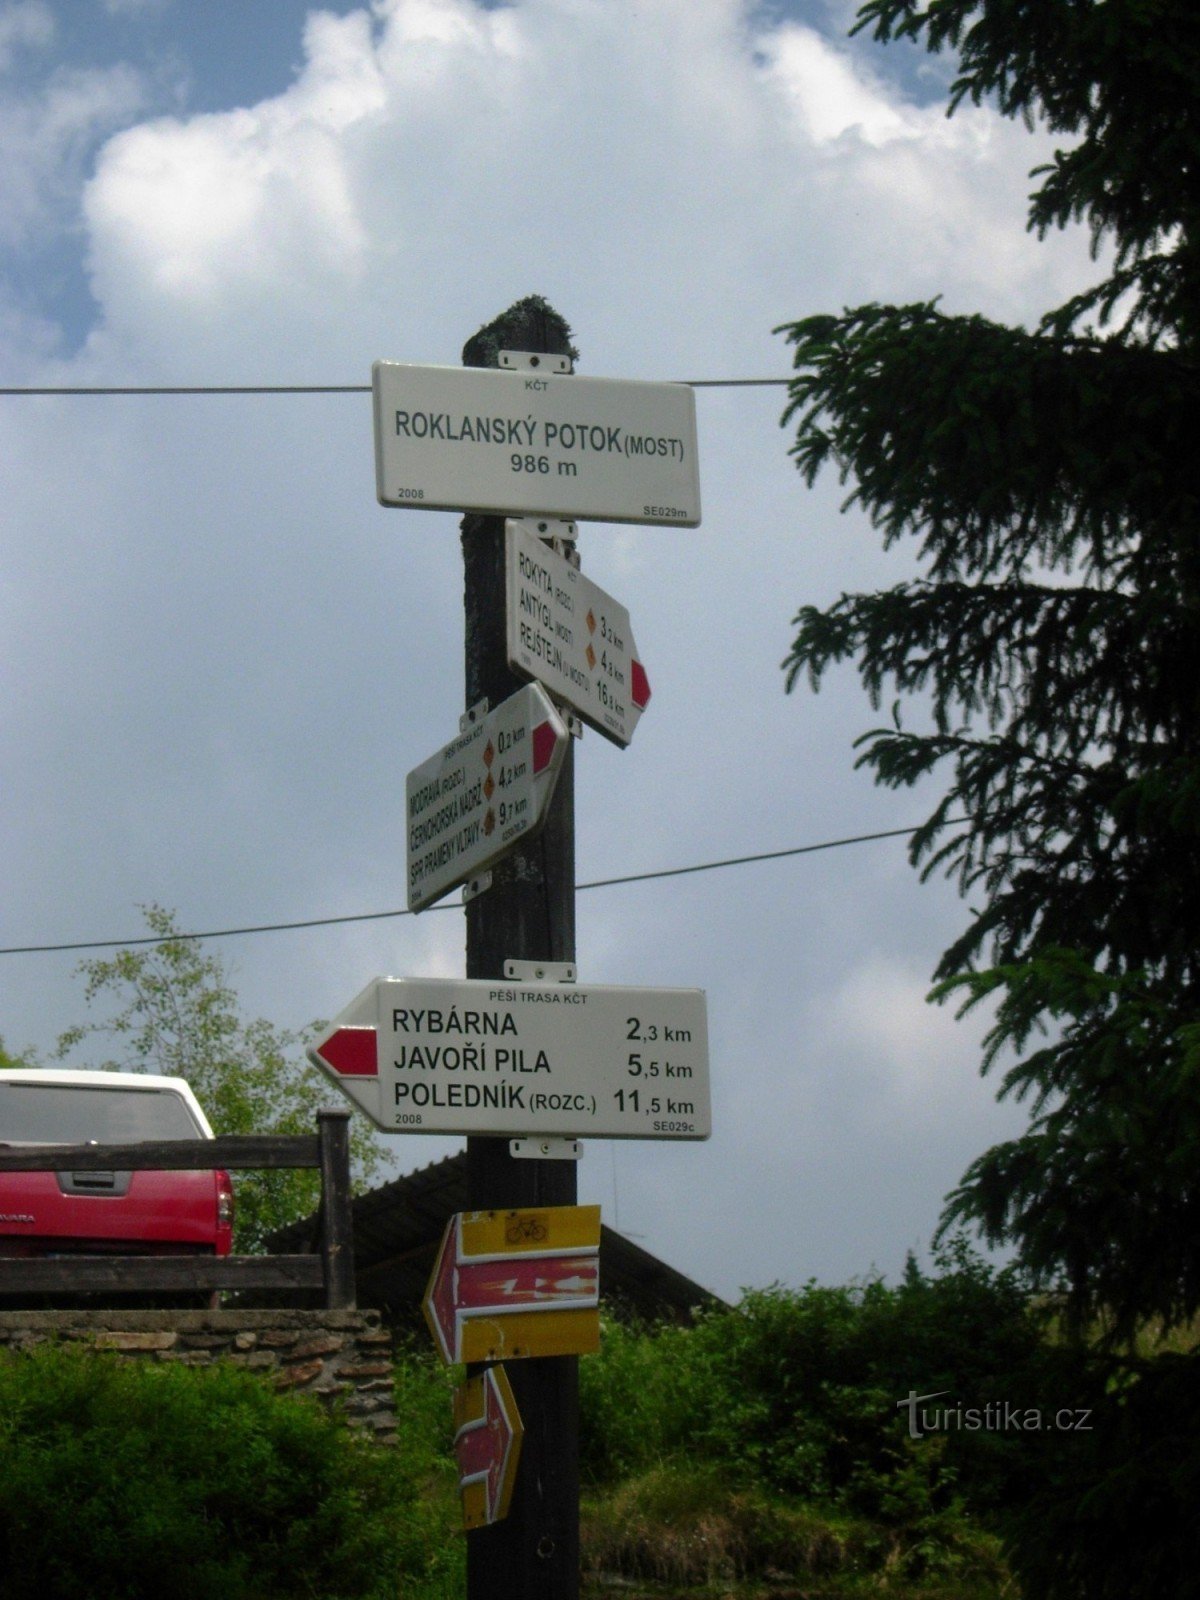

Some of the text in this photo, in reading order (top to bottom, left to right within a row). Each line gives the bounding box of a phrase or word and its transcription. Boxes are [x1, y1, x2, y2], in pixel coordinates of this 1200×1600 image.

[525, 379, 548, 392] KČT
[395, 410, 537, 447] ROKLANSKÝ
[545, 421, 622, 453] POTOK
[511, 453, 578, 476] 986 m
[398, 487, 424, 499] 2008
[643, 505, 688, 518] SE029m
[519, 551, 552, 597] ROKYTA
[520, 588, 553, 632] ANTÝGL
[520, 621, 562, 673] REJŠTEJN
[512, 727, 525, 744] km
[514, 763, 526, 780] km
[515, 798, 527, 815] km
[520, 992, 560, 1003] TRASA
[563, 993, 588, 1004] KČT
[392, 1005, 692, 1043] RYBÁRNA 2,3 km
[394, 1041, 693, 1079] JAVOŘÍ PILA 5,5 km
[394, 1080, 695, 1116] POLEDNÍK (ROZC.) 11,5 km
[395, 1114, 422, 1125] 2008
[653, 1121, 695, 1132] SE029c
